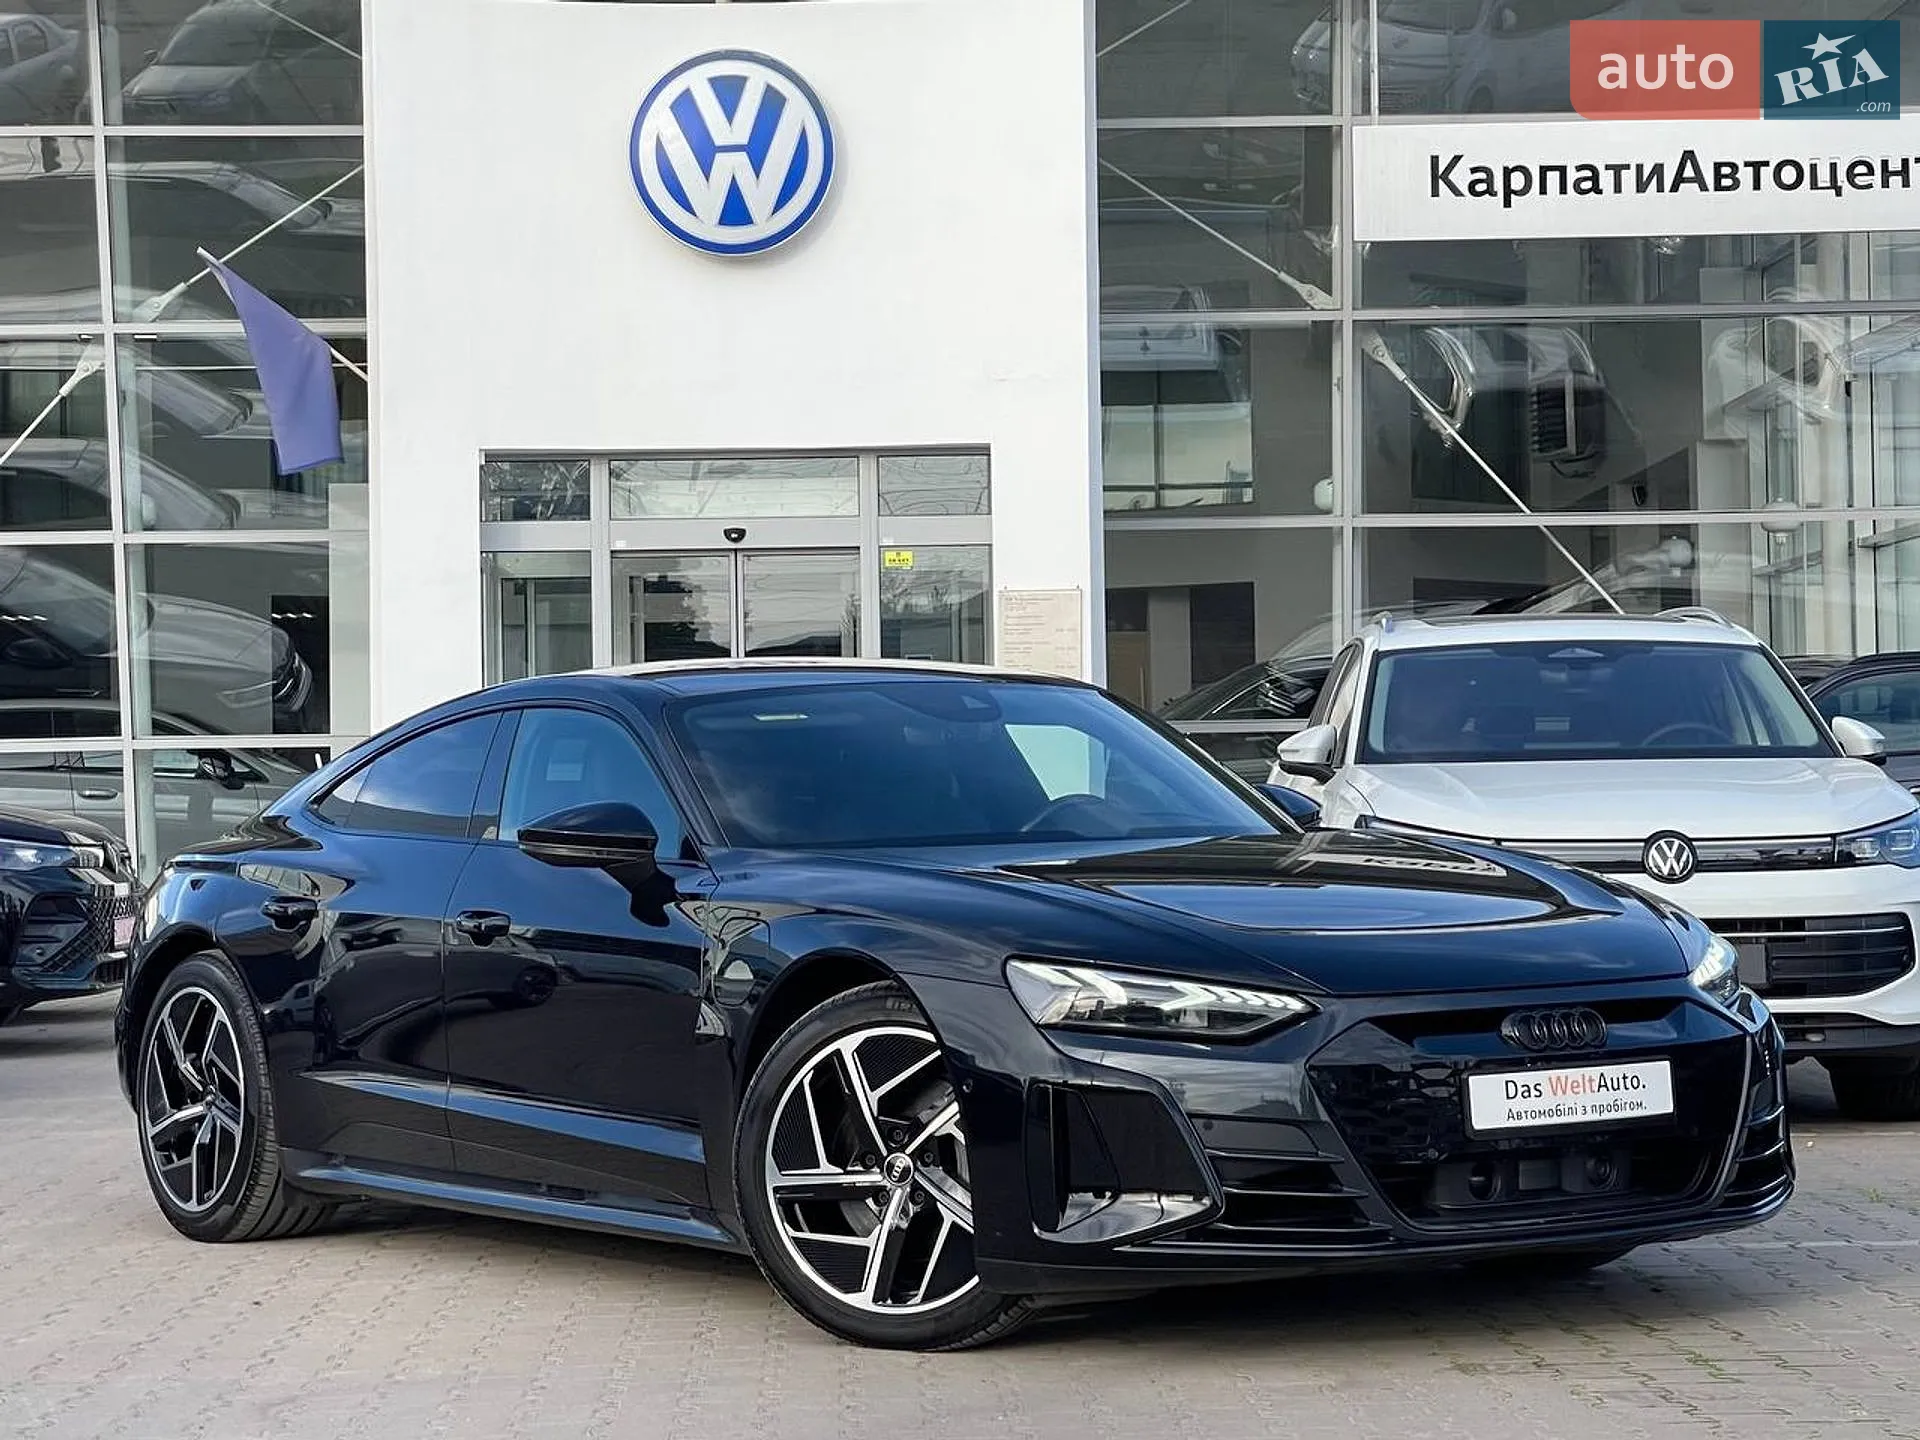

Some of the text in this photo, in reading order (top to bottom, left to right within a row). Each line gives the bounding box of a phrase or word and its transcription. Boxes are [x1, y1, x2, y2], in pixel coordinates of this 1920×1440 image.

[1431, 150, 1920, 208] КарпатиАвтоцен
[1505, 1072, 1646, 1100] Das WeltAuto.
[1507, 1099, 1647, 1121] Автомобілі з пробігом.
